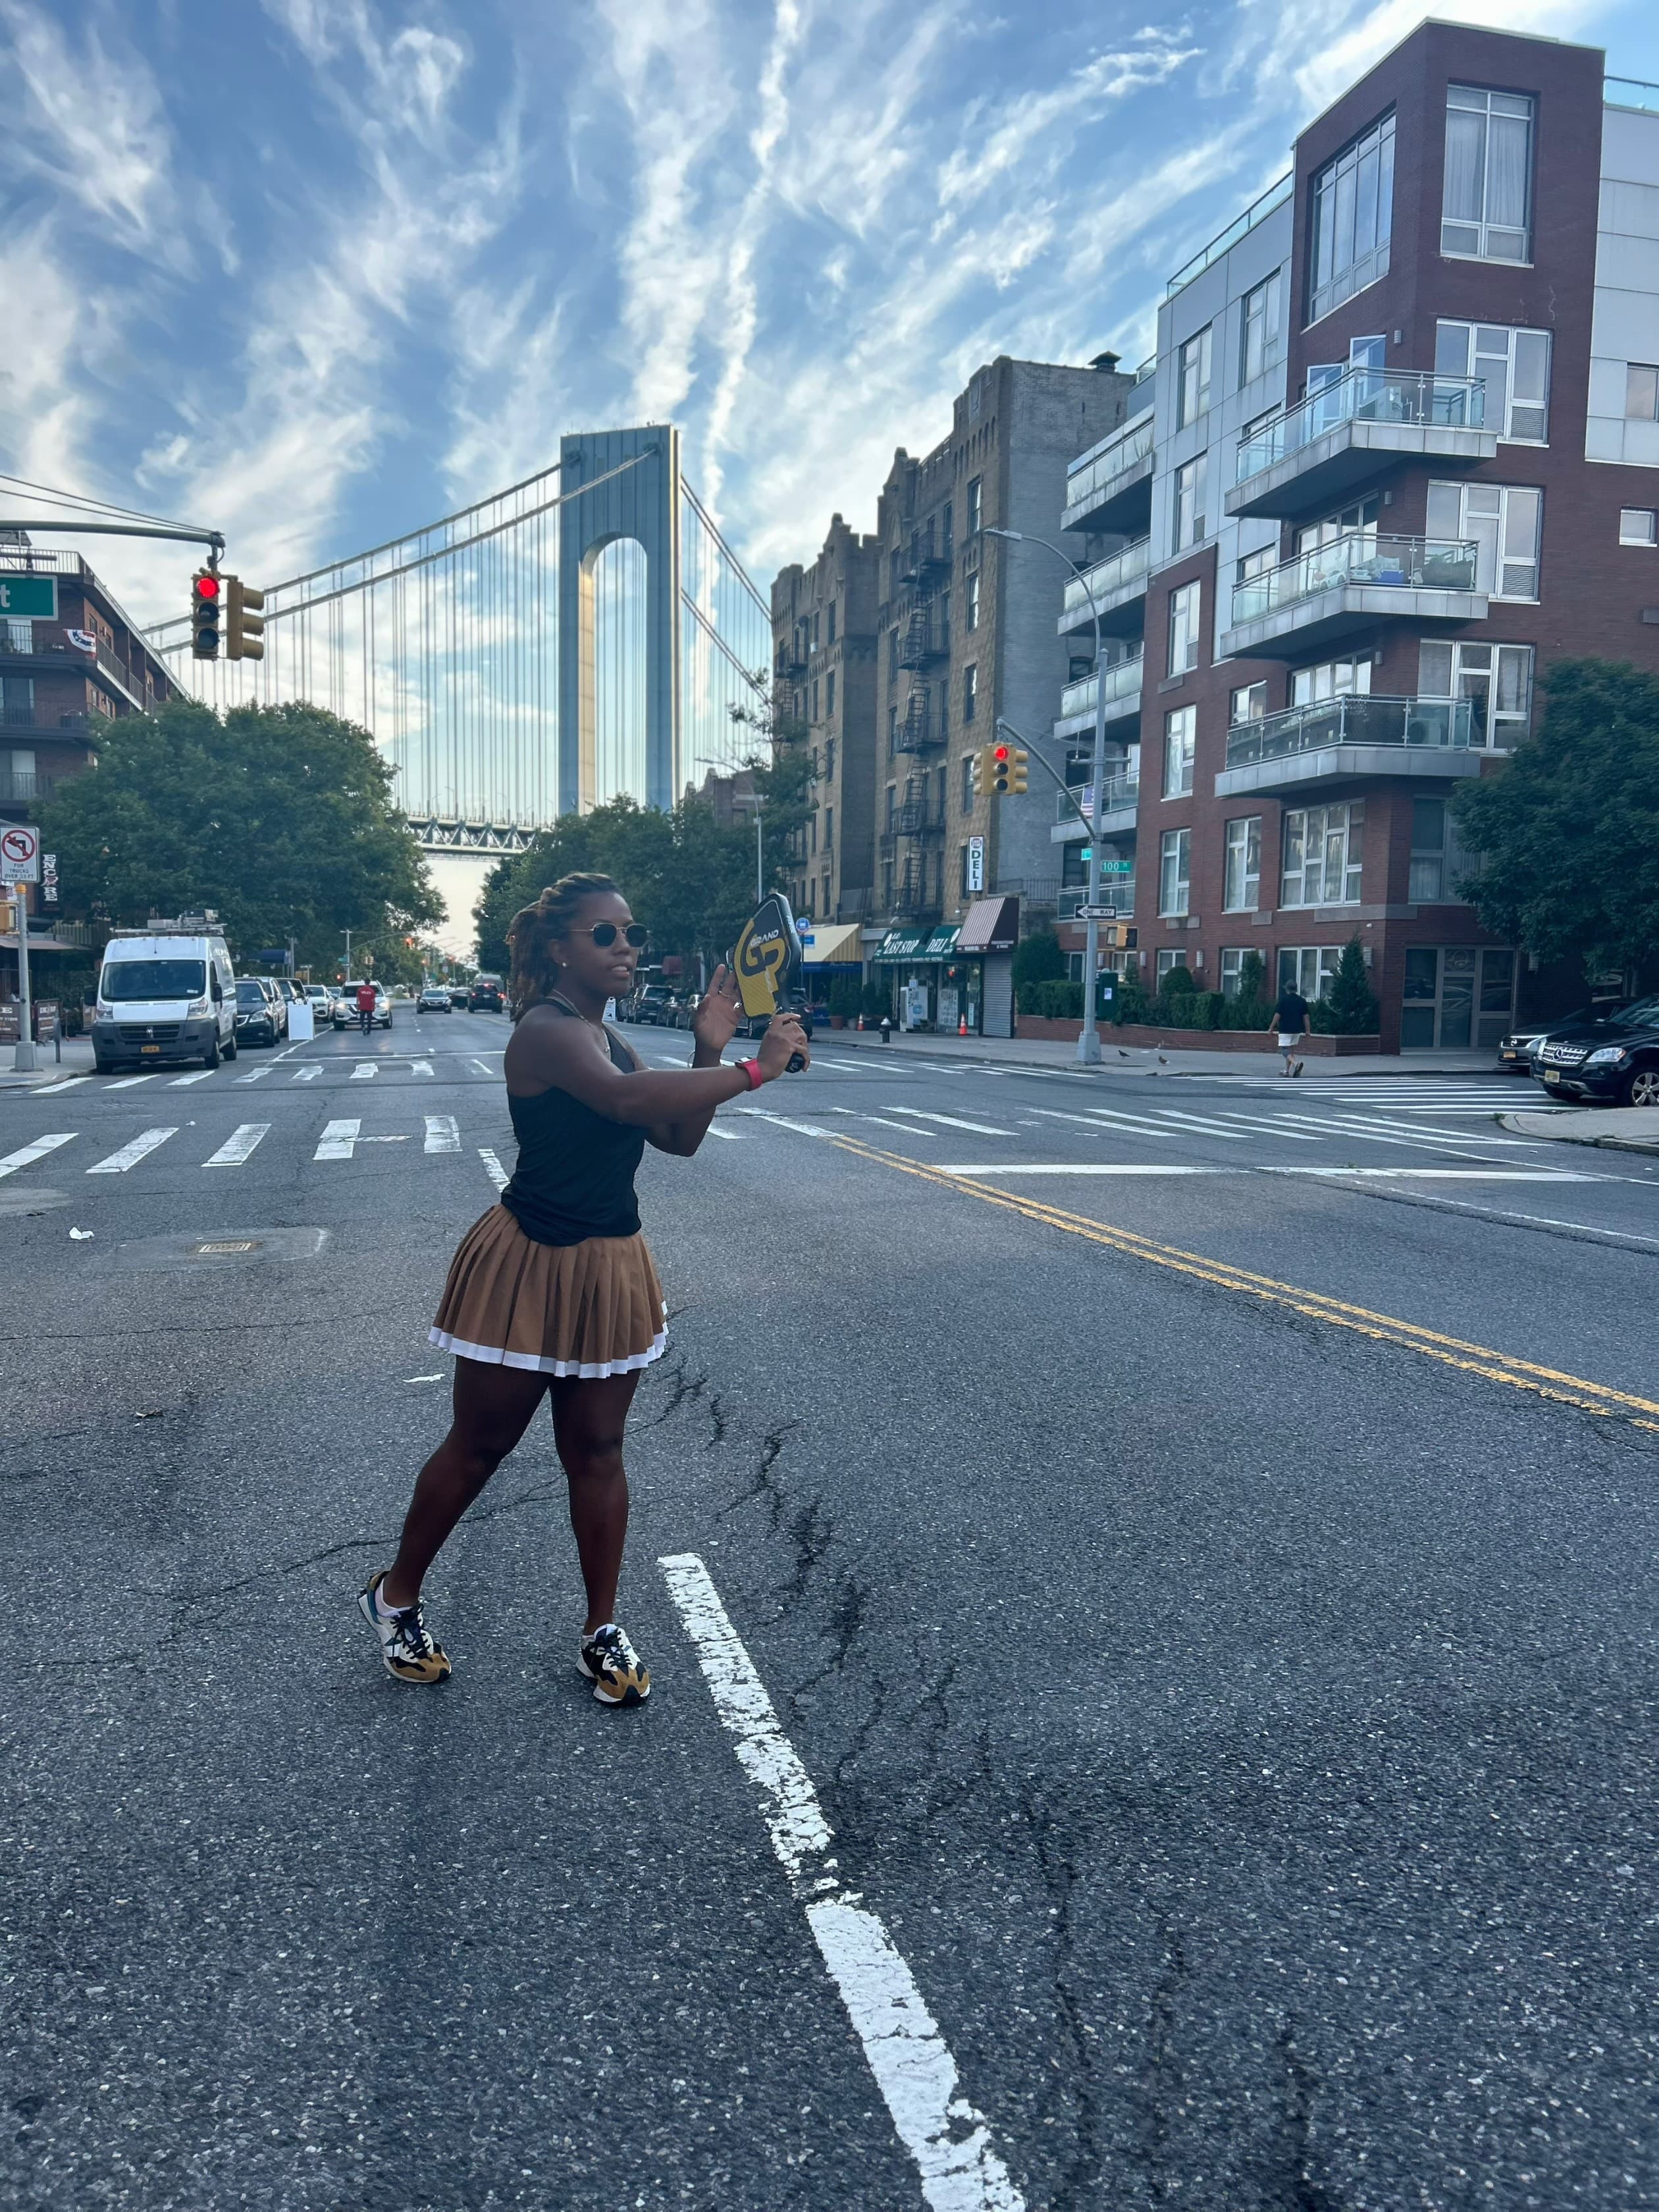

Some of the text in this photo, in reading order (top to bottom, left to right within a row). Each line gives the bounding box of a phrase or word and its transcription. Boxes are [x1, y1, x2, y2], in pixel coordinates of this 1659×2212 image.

[971, 850, 981, 889] DELI
[1103, 862, 1119, 870] 100
[883, 941, 903, 954] LAST
[899, 939, 920, 954] STOP
[925, 938, 949, 952] DELI
